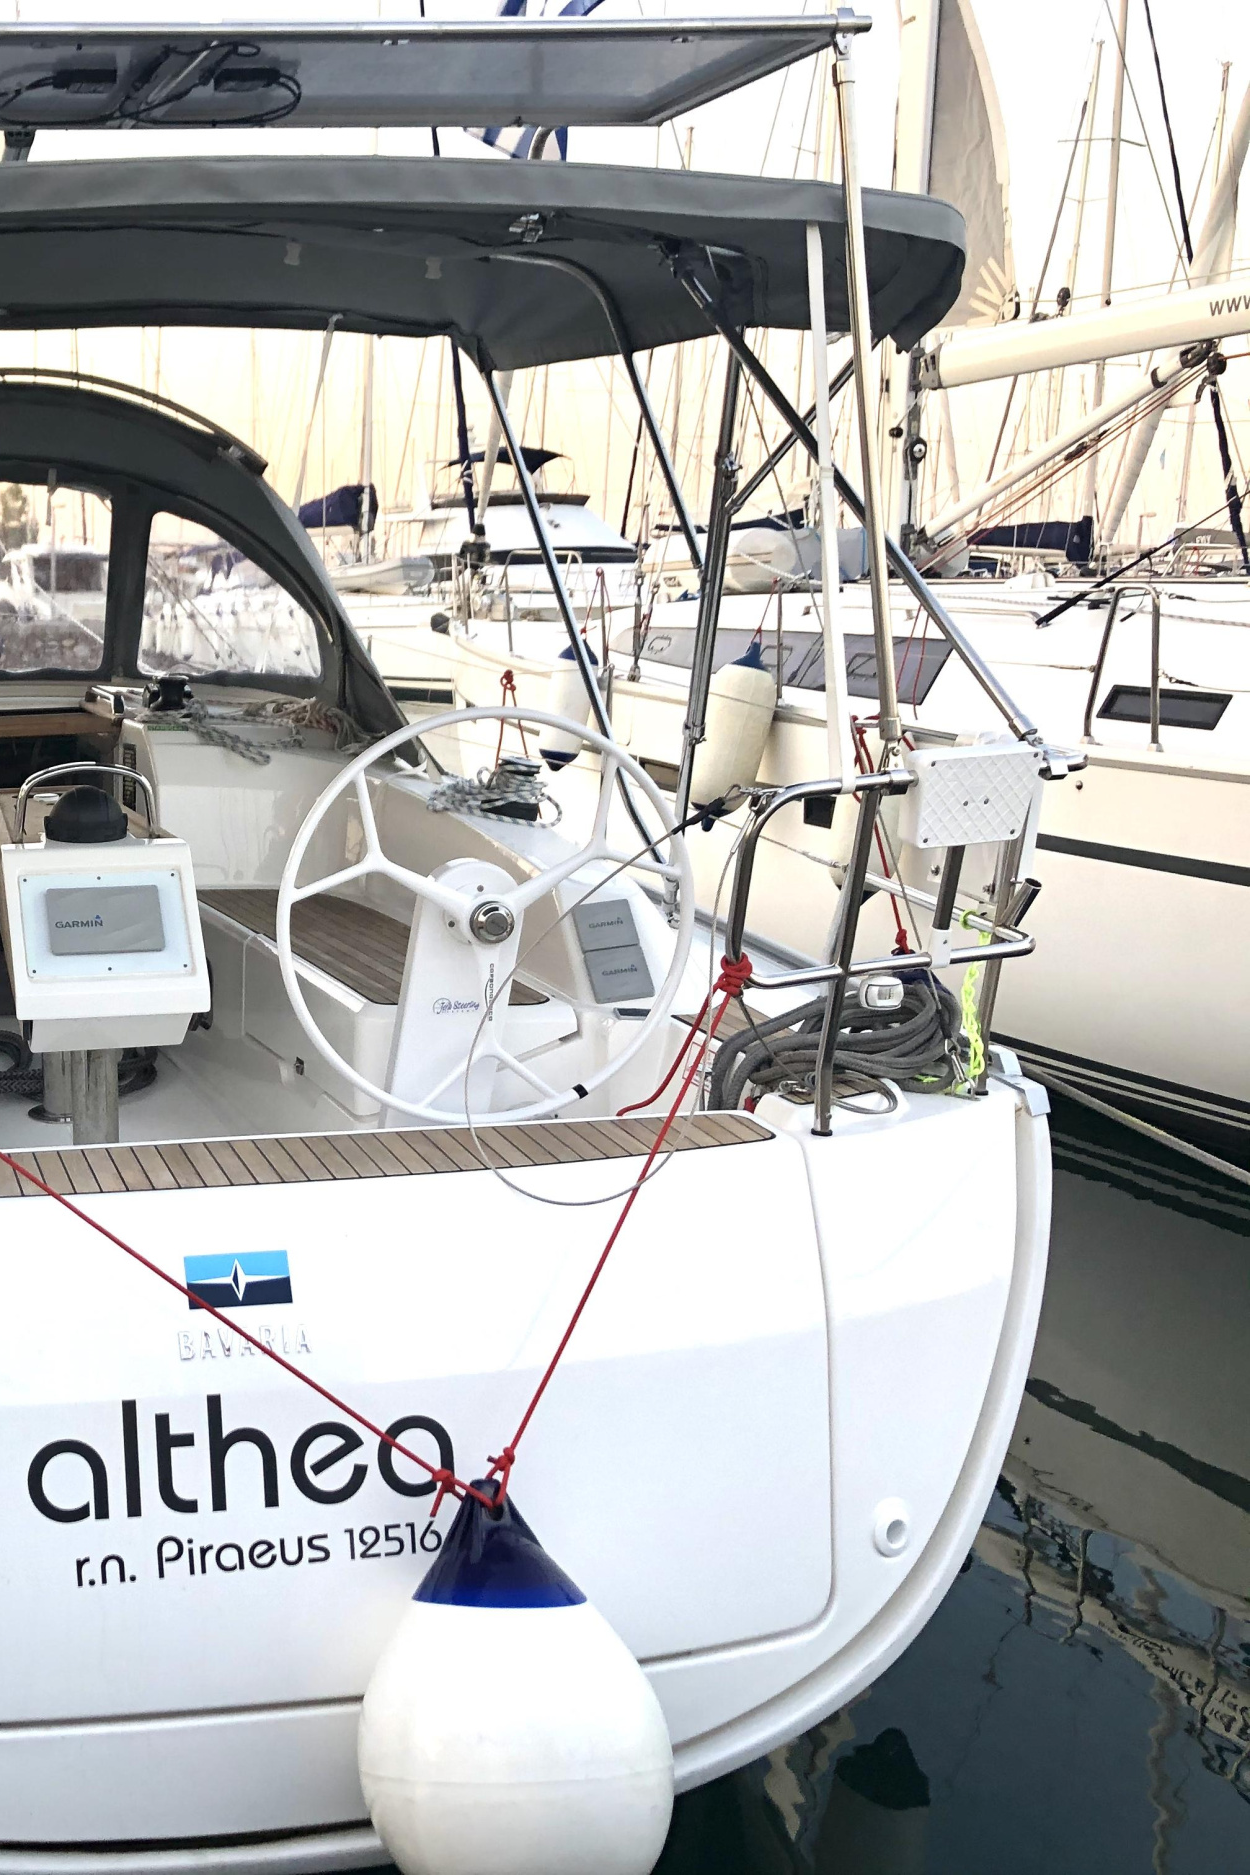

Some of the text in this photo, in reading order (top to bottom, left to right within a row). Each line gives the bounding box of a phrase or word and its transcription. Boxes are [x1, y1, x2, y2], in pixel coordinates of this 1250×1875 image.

[54, 919, 104, 929] GARMIN
[588, 918, 624, 929] GARMIN
[601, 966, 638, 977] GARMIN
[177, 1323, 312, 1361] BAVARIA
[27, 1393, 456, 1524] althea
[75, 1519, 443, 1588] r.n. Piraeus 12516
